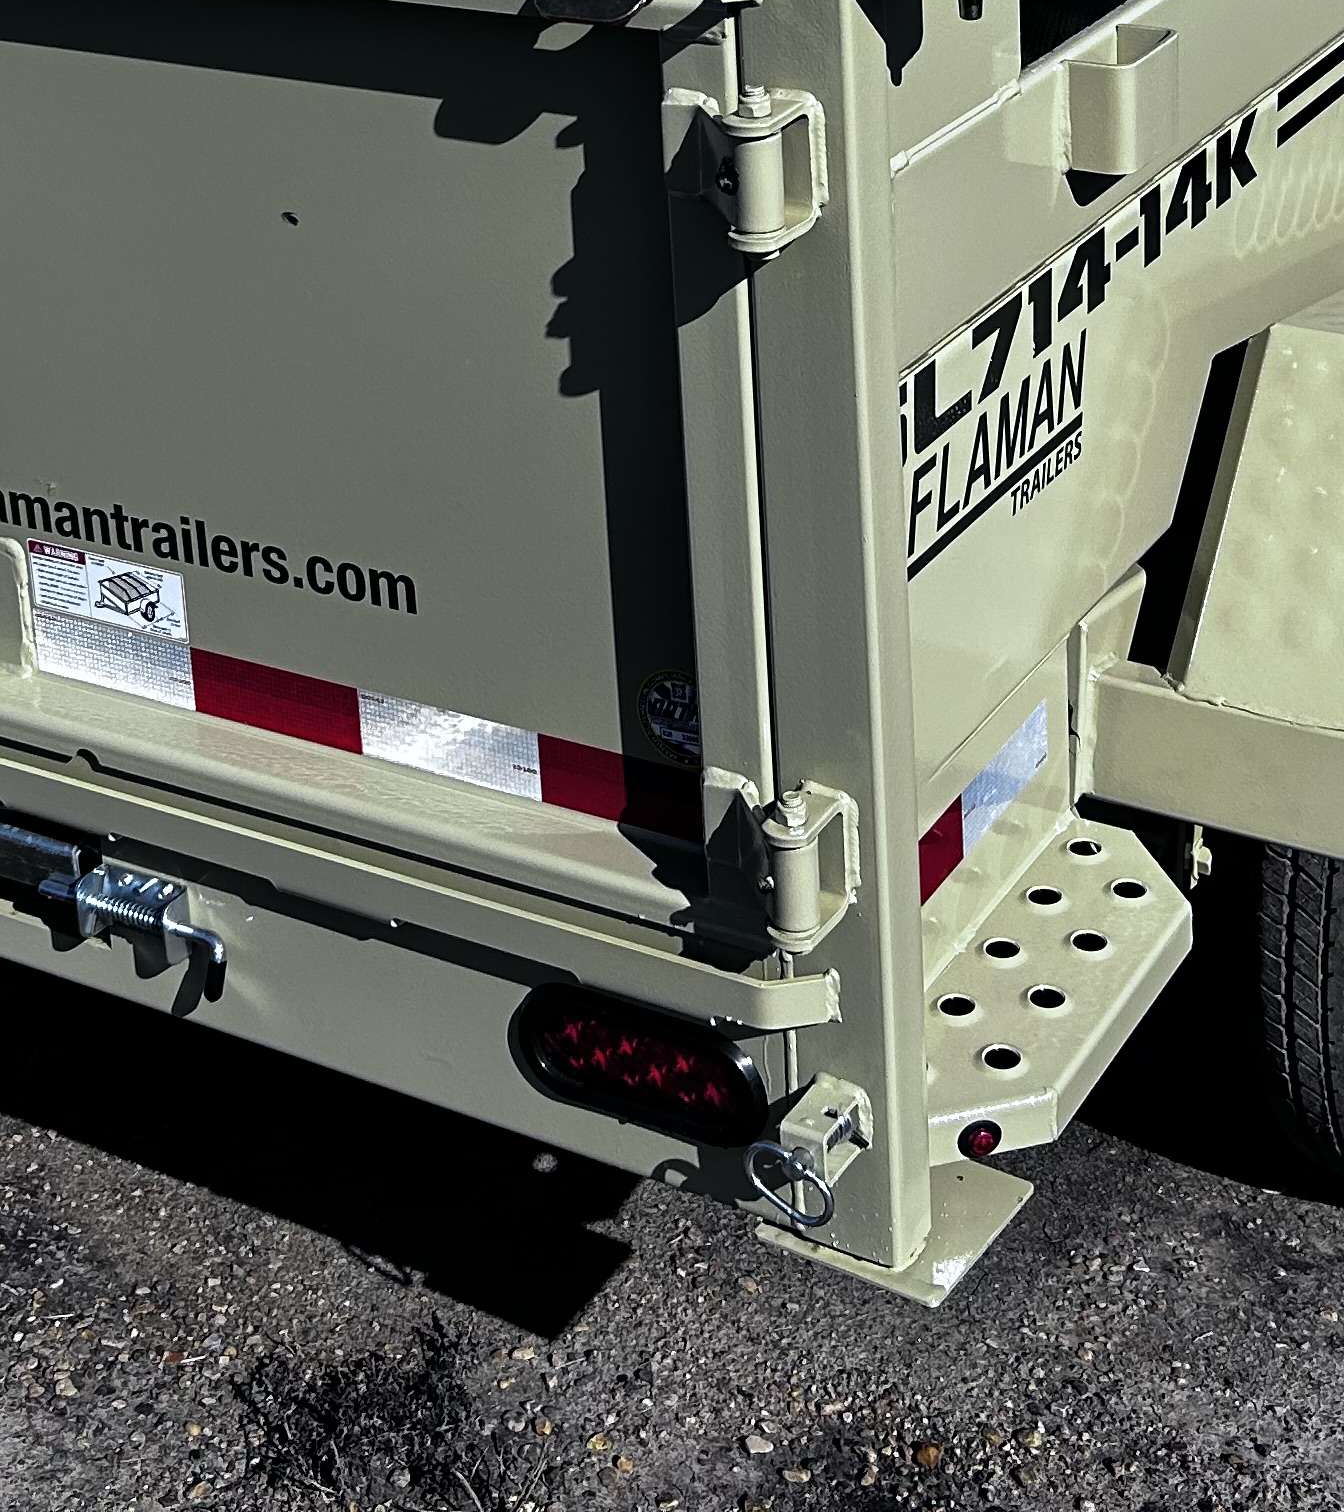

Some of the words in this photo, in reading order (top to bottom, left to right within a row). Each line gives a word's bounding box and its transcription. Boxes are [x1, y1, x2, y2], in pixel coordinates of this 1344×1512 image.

[899, 108, 1258, 467] L714-14K
[906, 327, 1087, 558] FLAMAN
[1010, 431, 1084, 517] TRAILERS
[42, 544, 80, 562] WARNING
